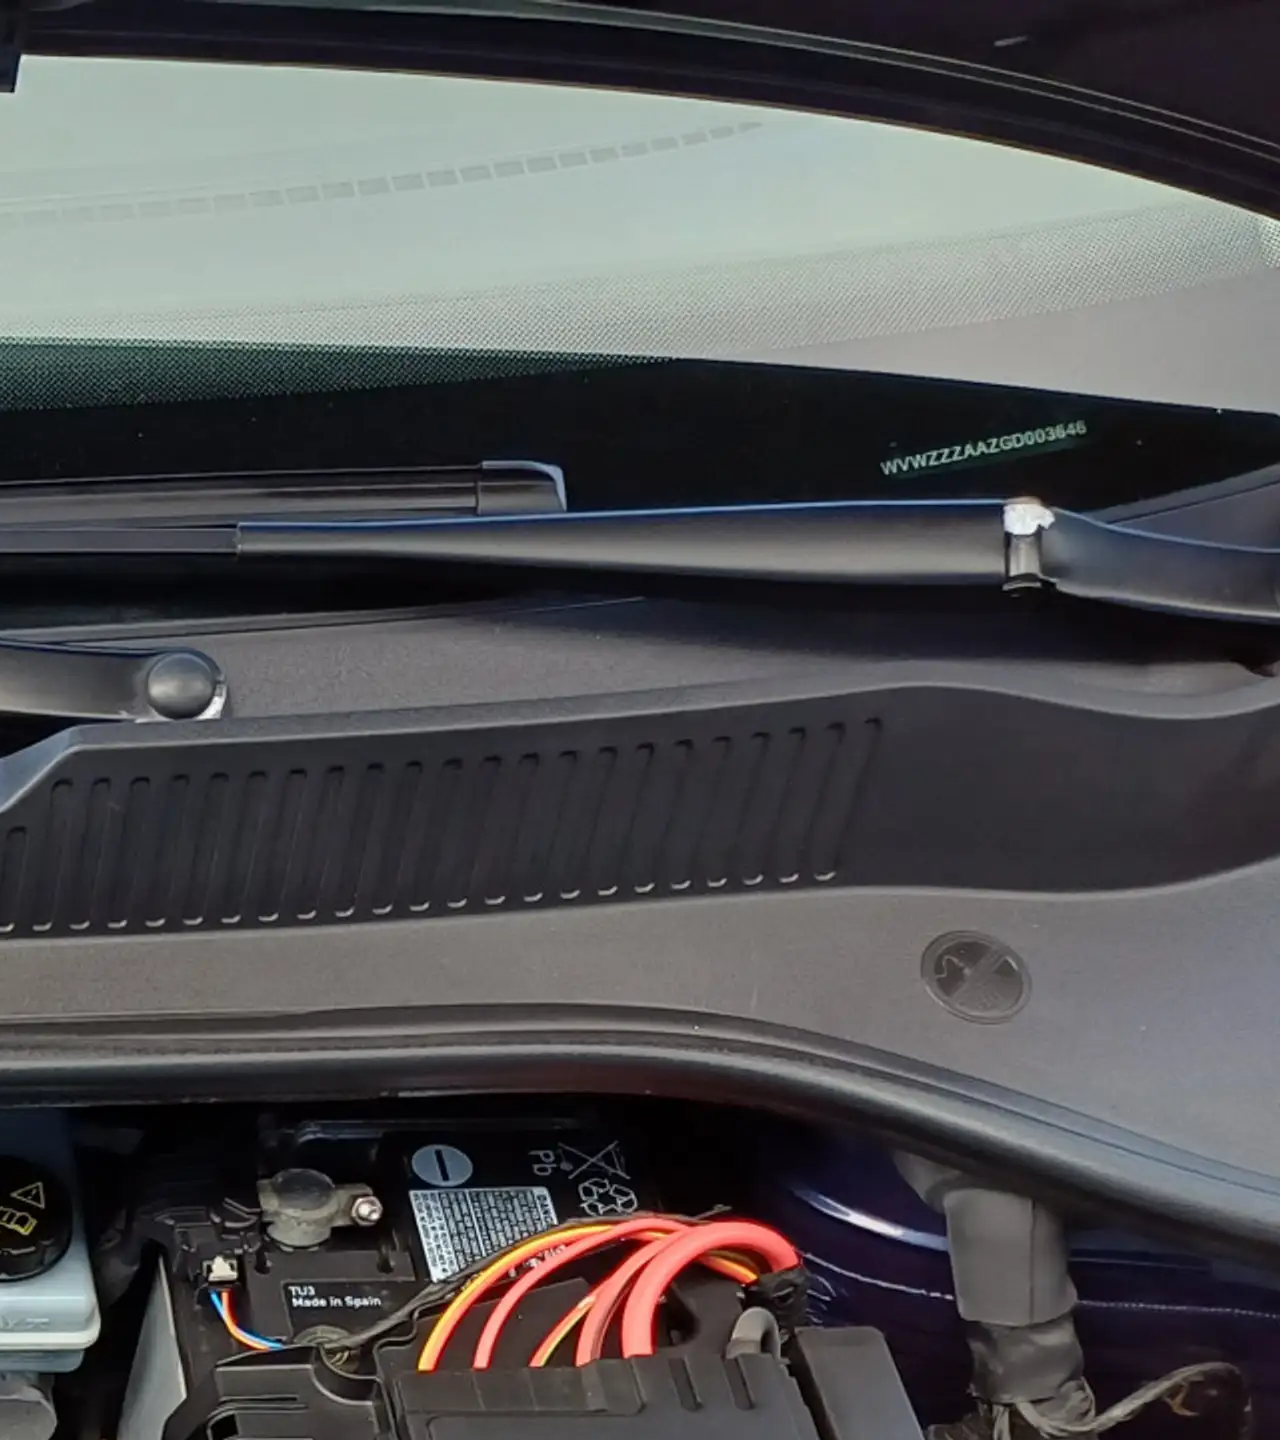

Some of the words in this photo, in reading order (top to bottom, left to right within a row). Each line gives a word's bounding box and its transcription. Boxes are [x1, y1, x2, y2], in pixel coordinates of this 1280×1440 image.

[287, 1285, 316, 1297] TU3
[291, 1297, 328, 1308] Made
[328, 1296, 344, 1308] in
[344, 1296, 382, 1310] Spain
